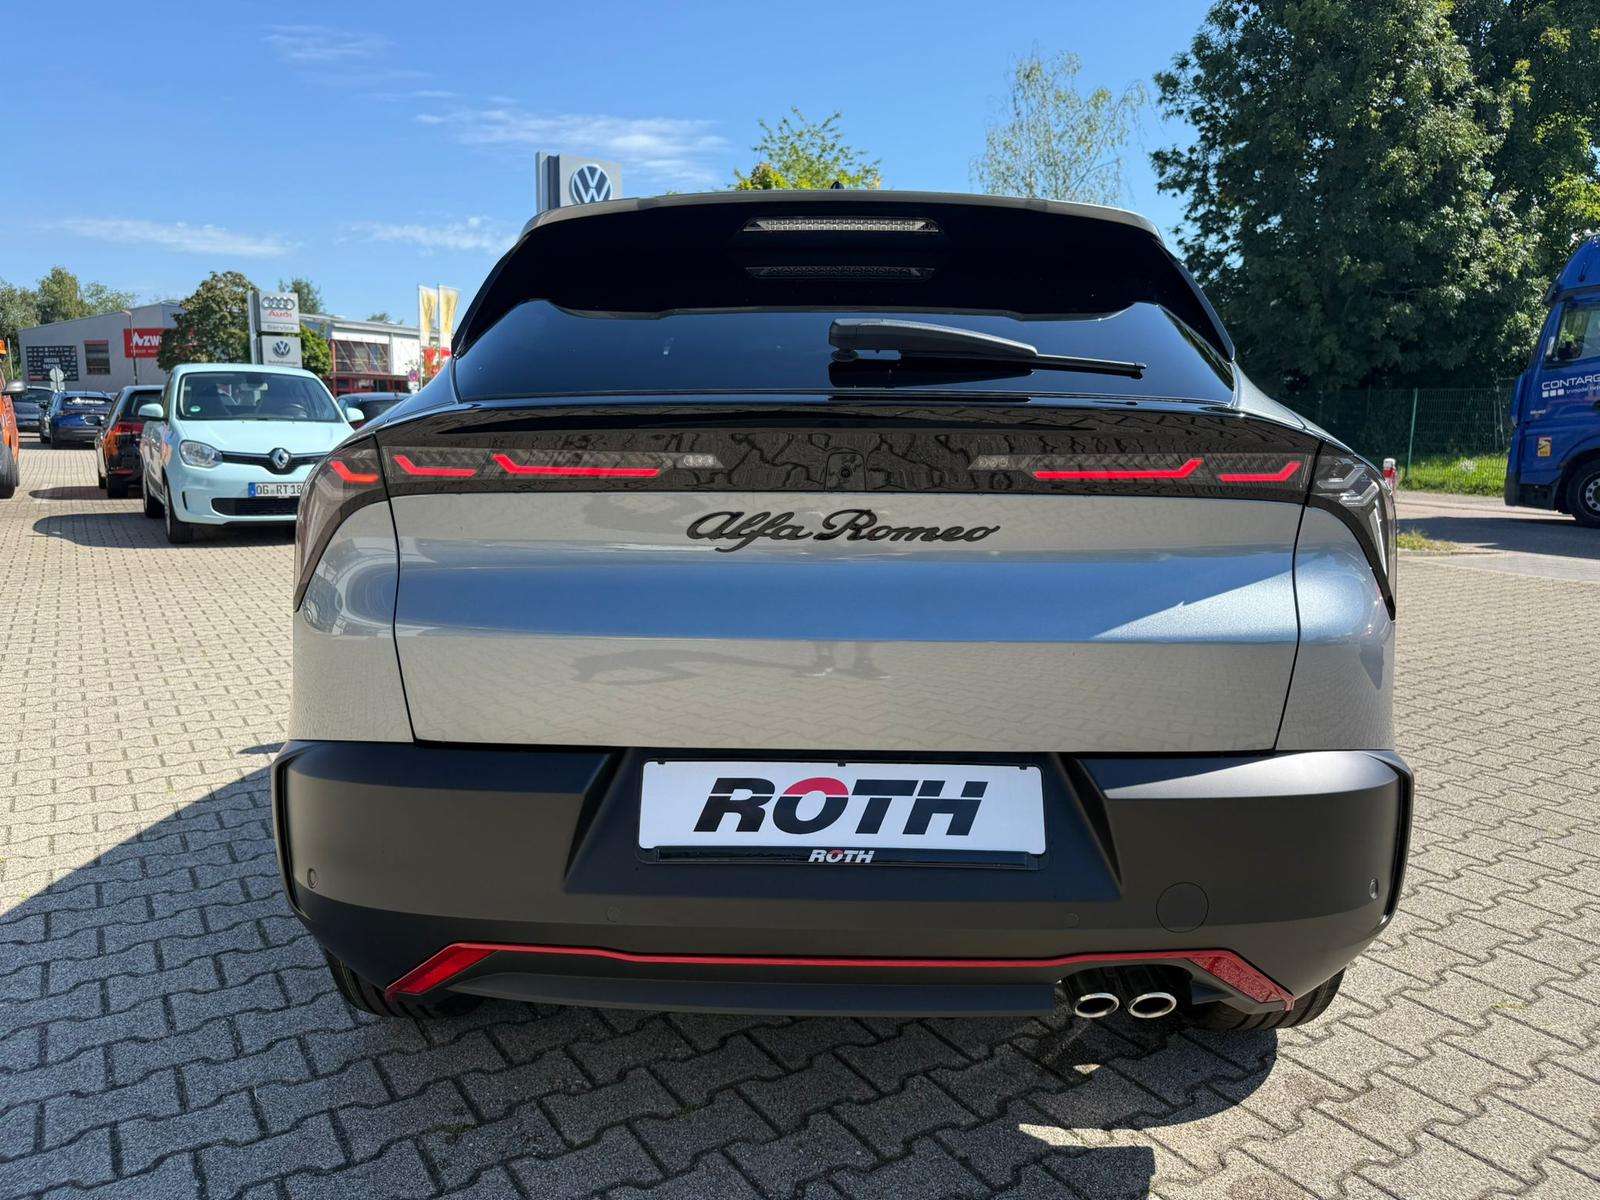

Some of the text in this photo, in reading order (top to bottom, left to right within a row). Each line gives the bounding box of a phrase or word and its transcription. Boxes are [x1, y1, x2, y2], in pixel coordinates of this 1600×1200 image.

[268, 310, 292, 319] Audi
[256, 484, 269, 495] OG
[686, 508, 1001, 552] Alfa Romeo
[693, 777, 989, 836] ROTH
[808, 849, 875, 864] ROTH
